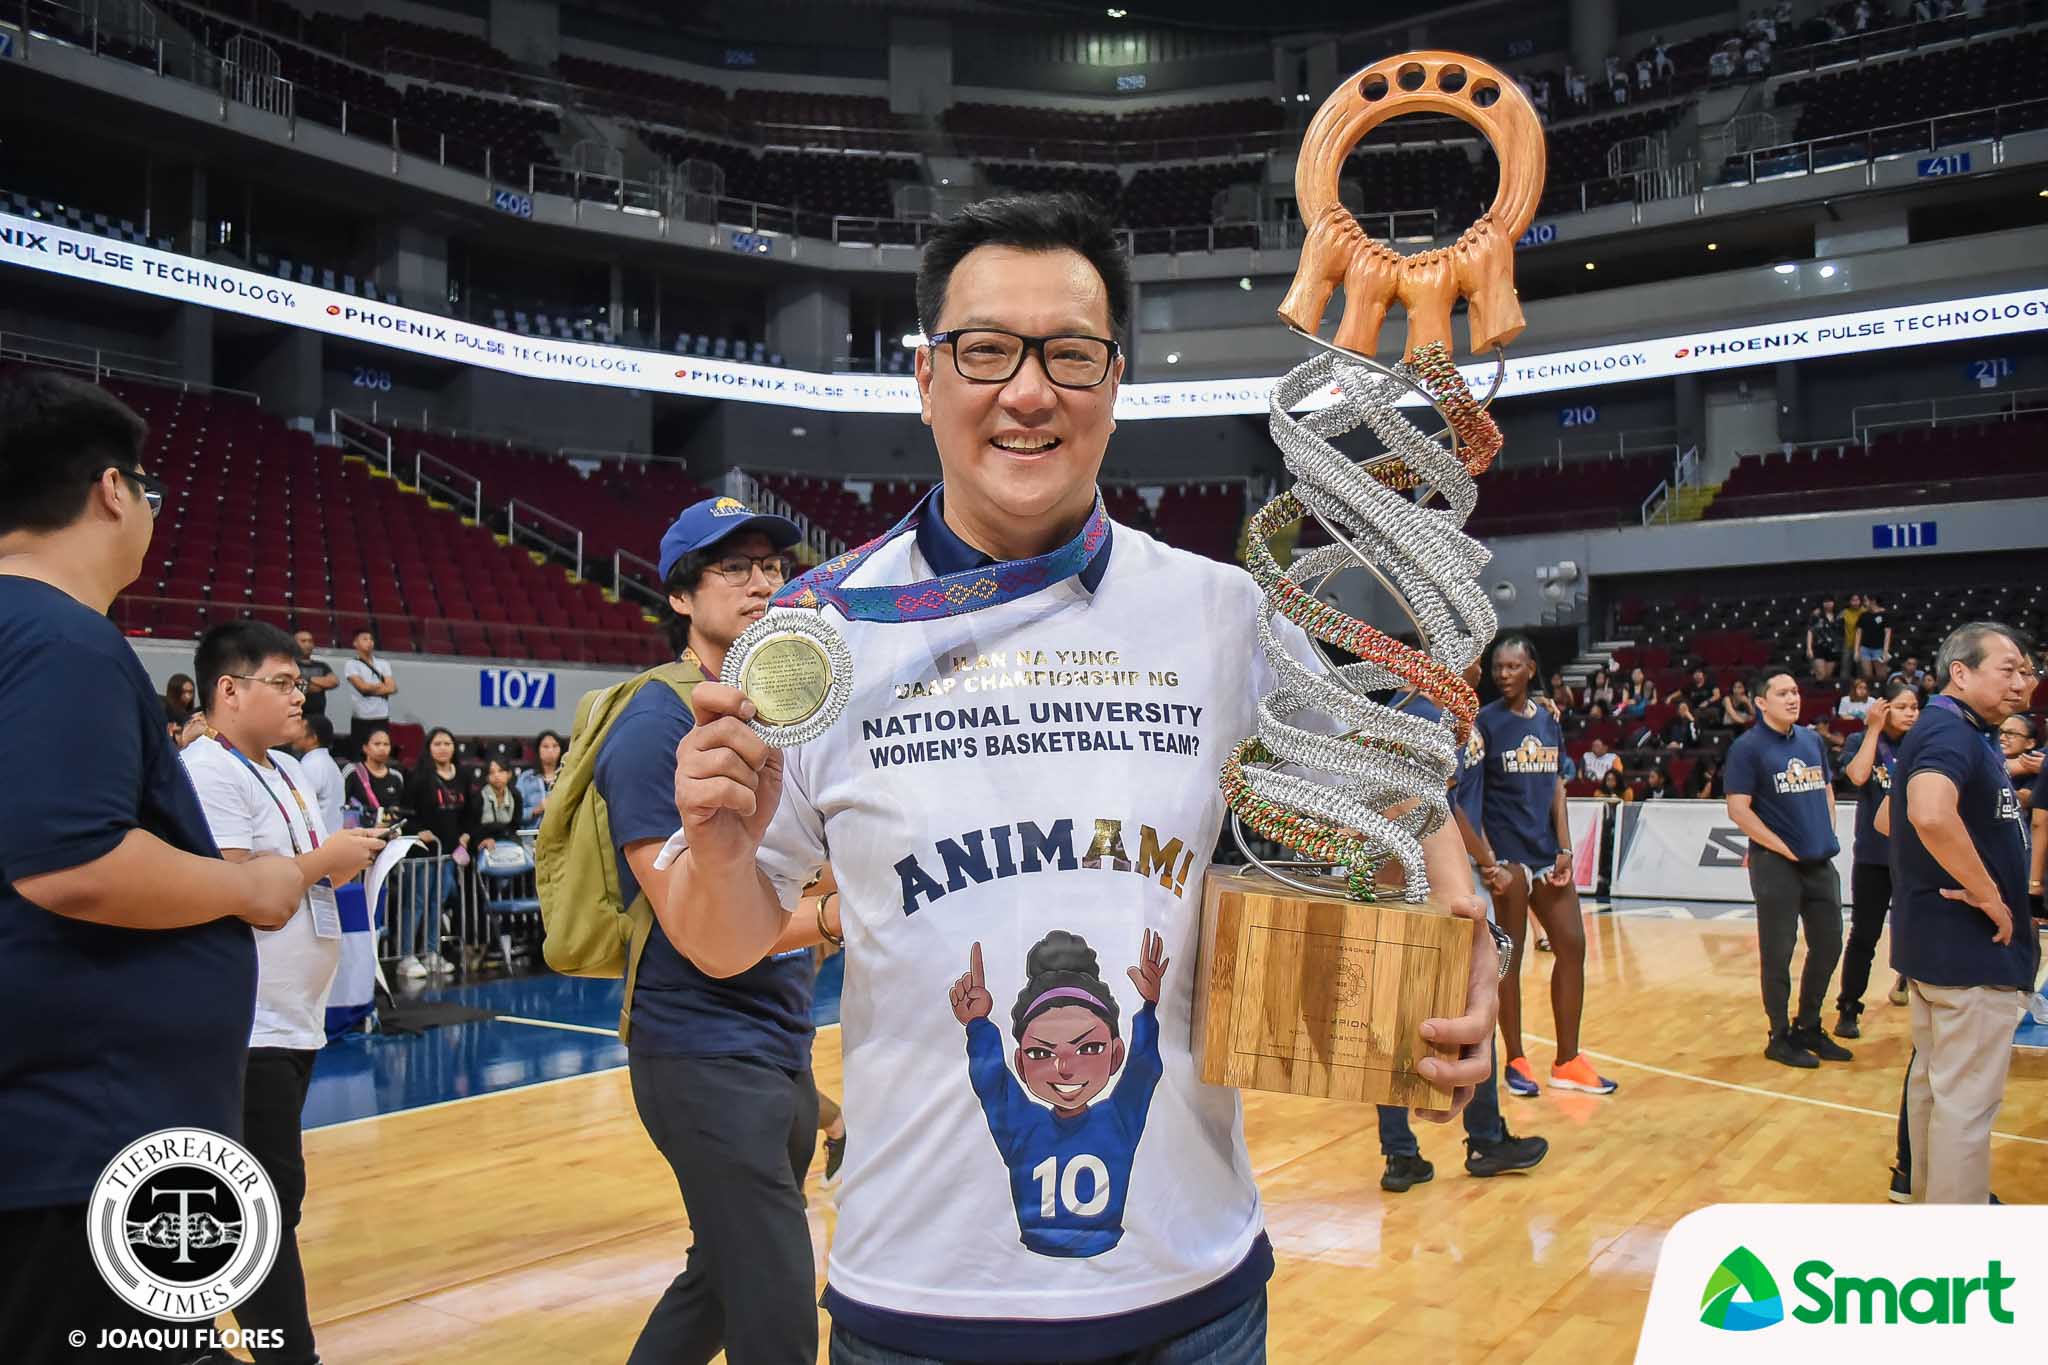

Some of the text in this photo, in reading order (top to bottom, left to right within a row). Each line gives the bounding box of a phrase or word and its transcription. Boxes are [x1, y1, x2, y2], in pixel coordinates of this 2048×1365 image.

[1928, 155, 1961, 176] 411
[58, 240, 133, 271] PULSE
[143, 260, 293, 307] TECHNOLOGY
[345, 307, 446, 342] PHOENIX
[455, 333, 505, 356] PULSE
[1694, 331, 1809, 357] PHOENIX
[1818, 321, 1885, 342] PULSE
[692, 370, 785, 391] PHOENIX
[1515, 352, 1643, 382] TECHNOLOGY
[1562, 406, 1596, 427] 210
[1888, 523, 1921, 547] 111
[1016, 650, 1048, 666] NA
[1055, 650, 1120, 666] YUNG
[488, 669, 549, 708] 107
[894, 670, 1179, 700] UAAP CHAMPIONSHIP NG
[862, 701, 1203, 741] NATIONAL UNIVERSITY
[869, 730, 1200, 770] WOMEN'S BASKETBALL TEAM?
[893, 818, 1195, 917] ANIMAM!
[1033, 1154, 1110, 1217] 10
